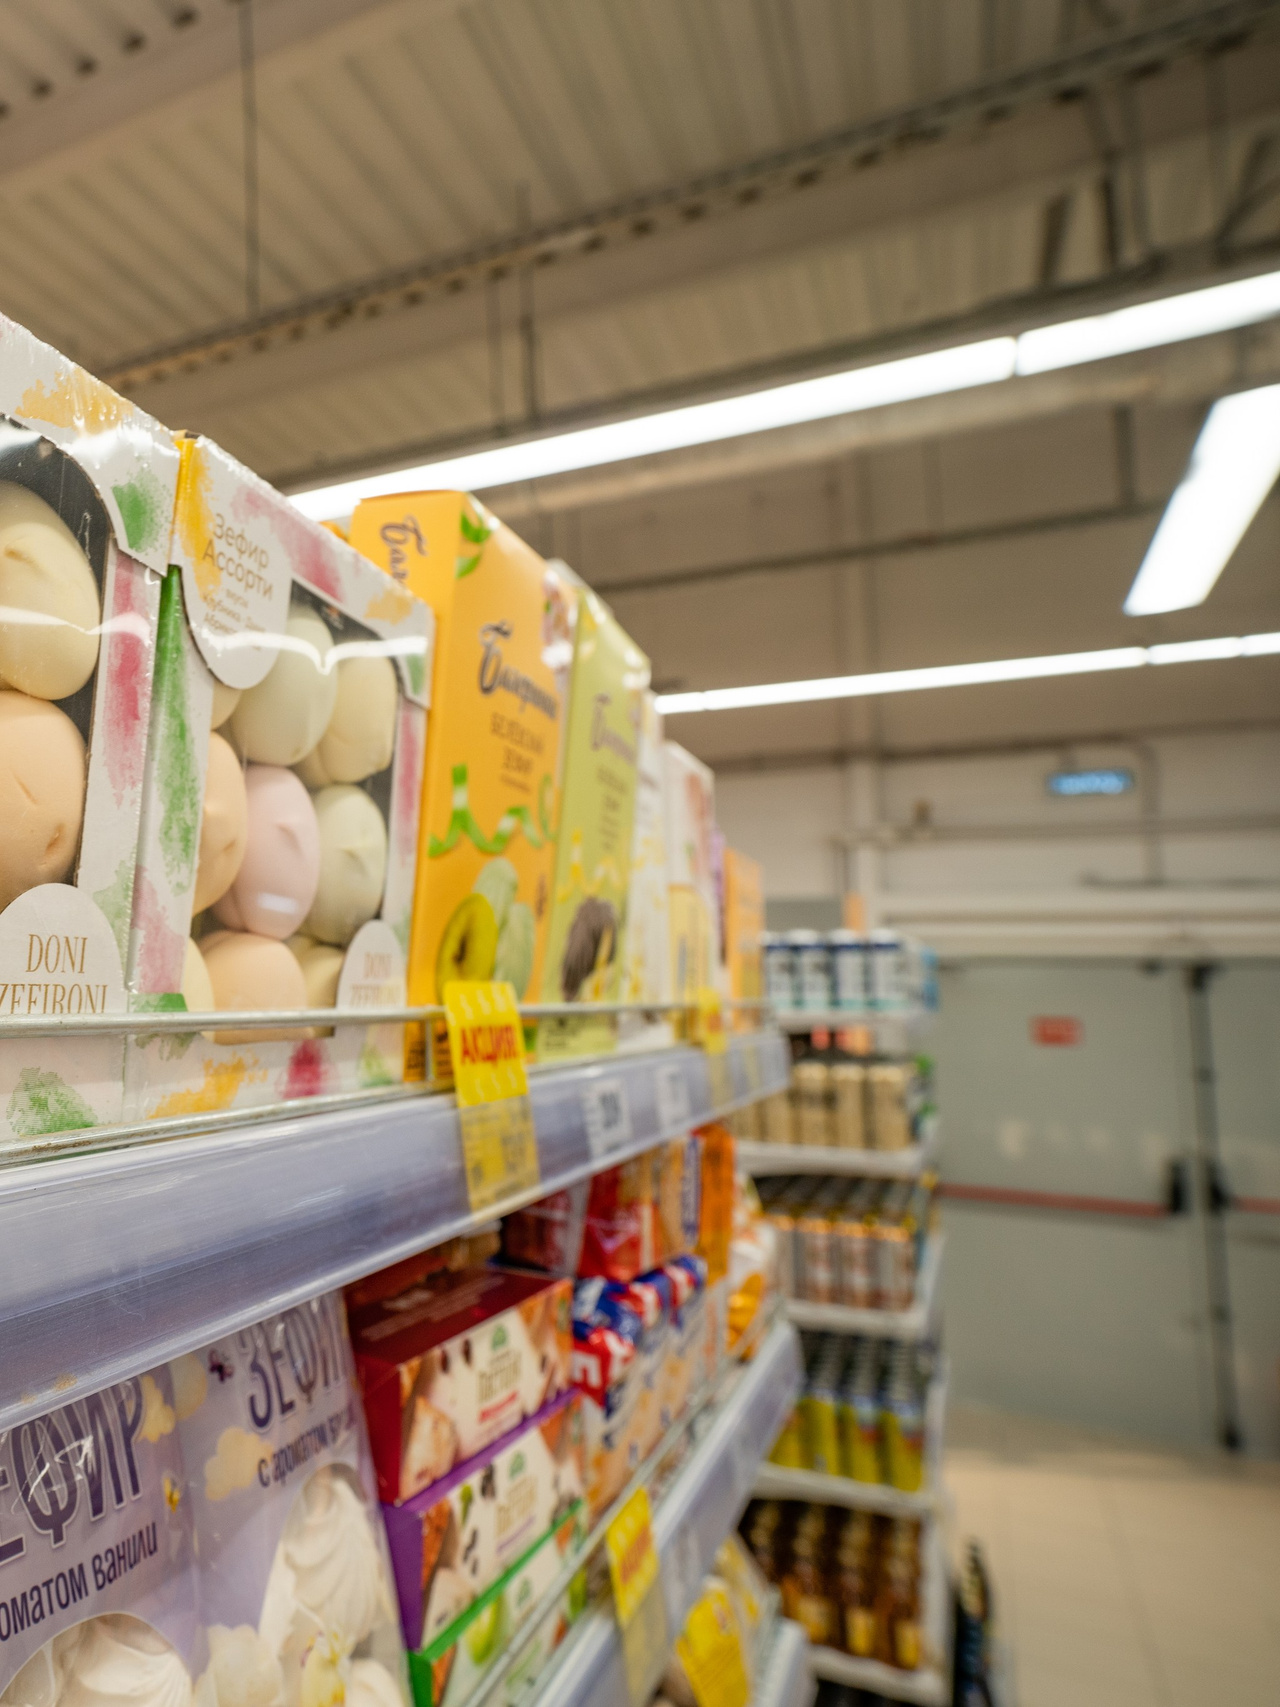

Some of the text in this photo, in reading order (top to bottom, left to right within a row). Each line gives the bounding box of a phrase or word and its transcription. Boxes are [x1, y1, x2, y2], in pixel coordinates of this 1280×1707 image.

[202, 539, 274, 601] Ассорти
[212, 512, 270, 572] Зефир
[25, 933, 89, 975] DONI
[94, 1521, 159, 1591] ванили
